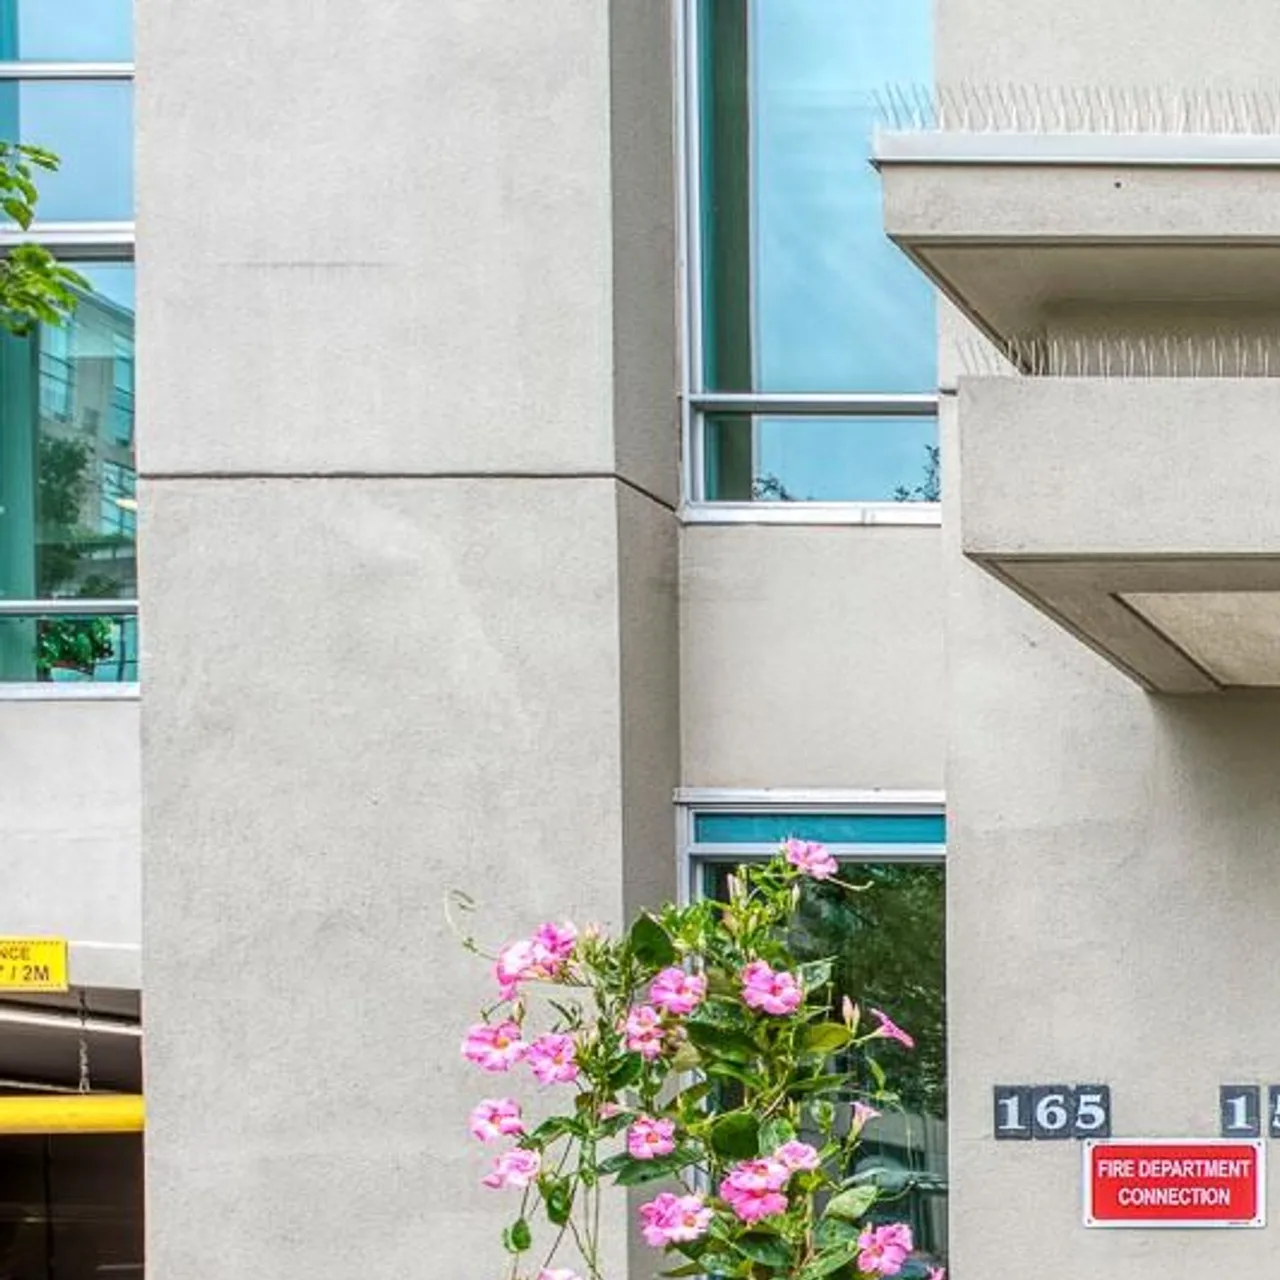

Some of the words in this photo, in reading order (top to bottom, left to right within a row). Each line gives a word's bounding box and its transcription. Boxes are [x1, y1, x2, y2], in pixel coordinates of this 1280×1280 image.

[23, 964, 50, 981] 2M
[998, 1094, 1106, 1130] 165
[1098, 1159, 1135, 1178] FIRE
[1139, 1159, 1252, 1178] DEPARTMENT
[1117, 1187, 1231, 1206] CONNECTION
